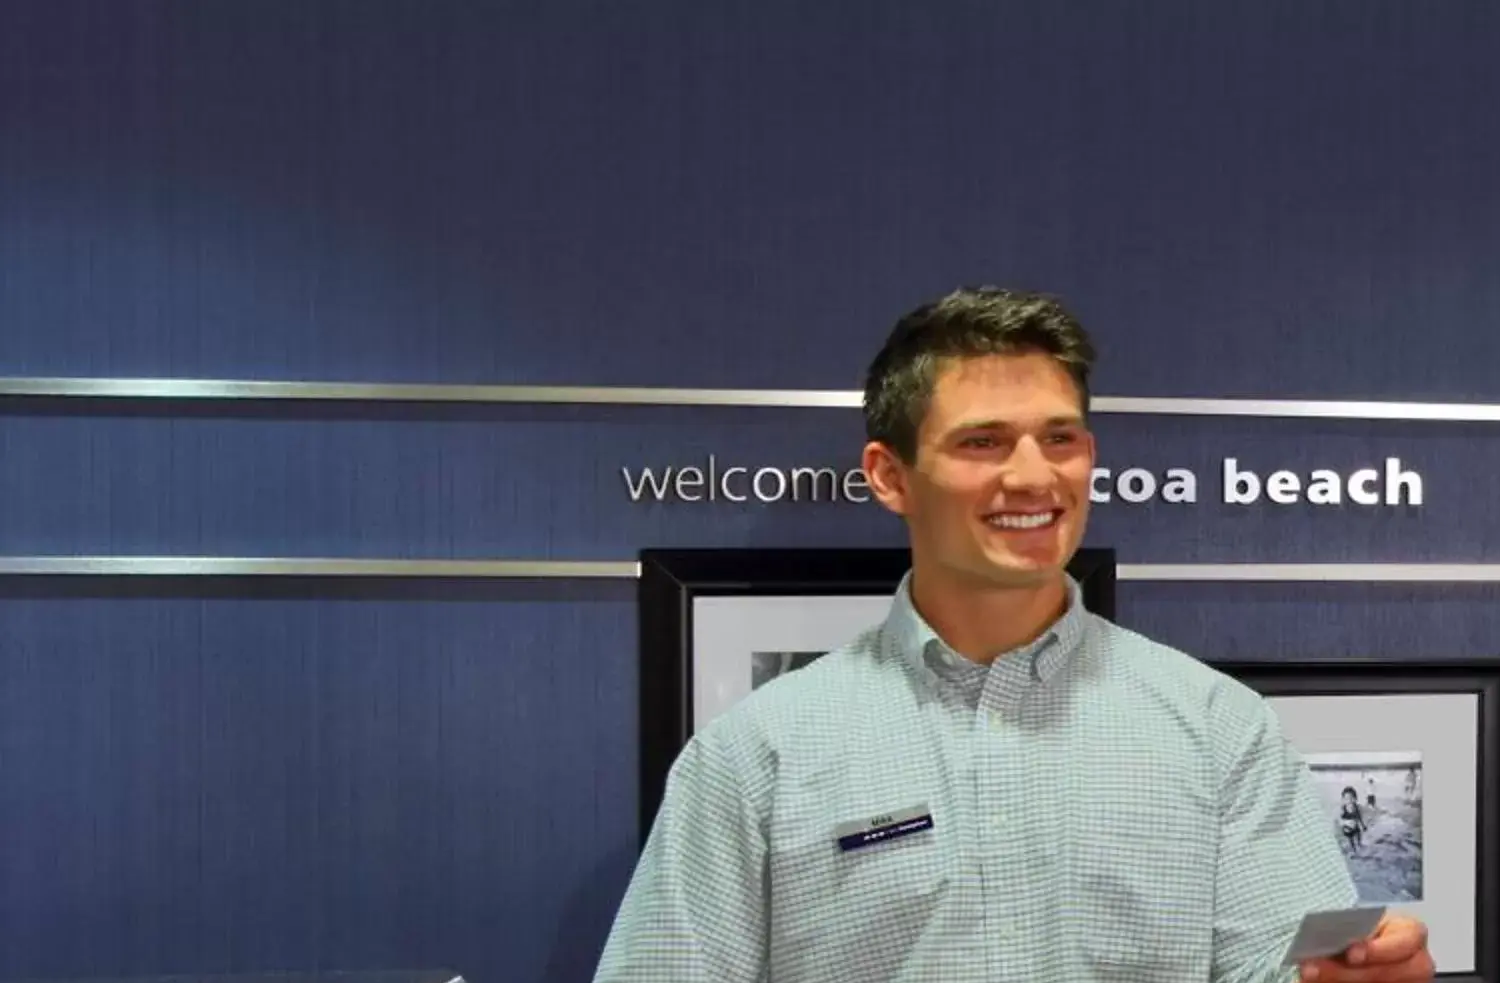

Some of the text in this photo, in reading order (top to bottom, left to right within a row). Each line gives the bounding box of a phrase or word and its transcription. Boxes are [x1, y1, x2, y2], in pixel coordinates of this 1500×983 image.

[621, 453, 1424, 505] welcome coa beach
